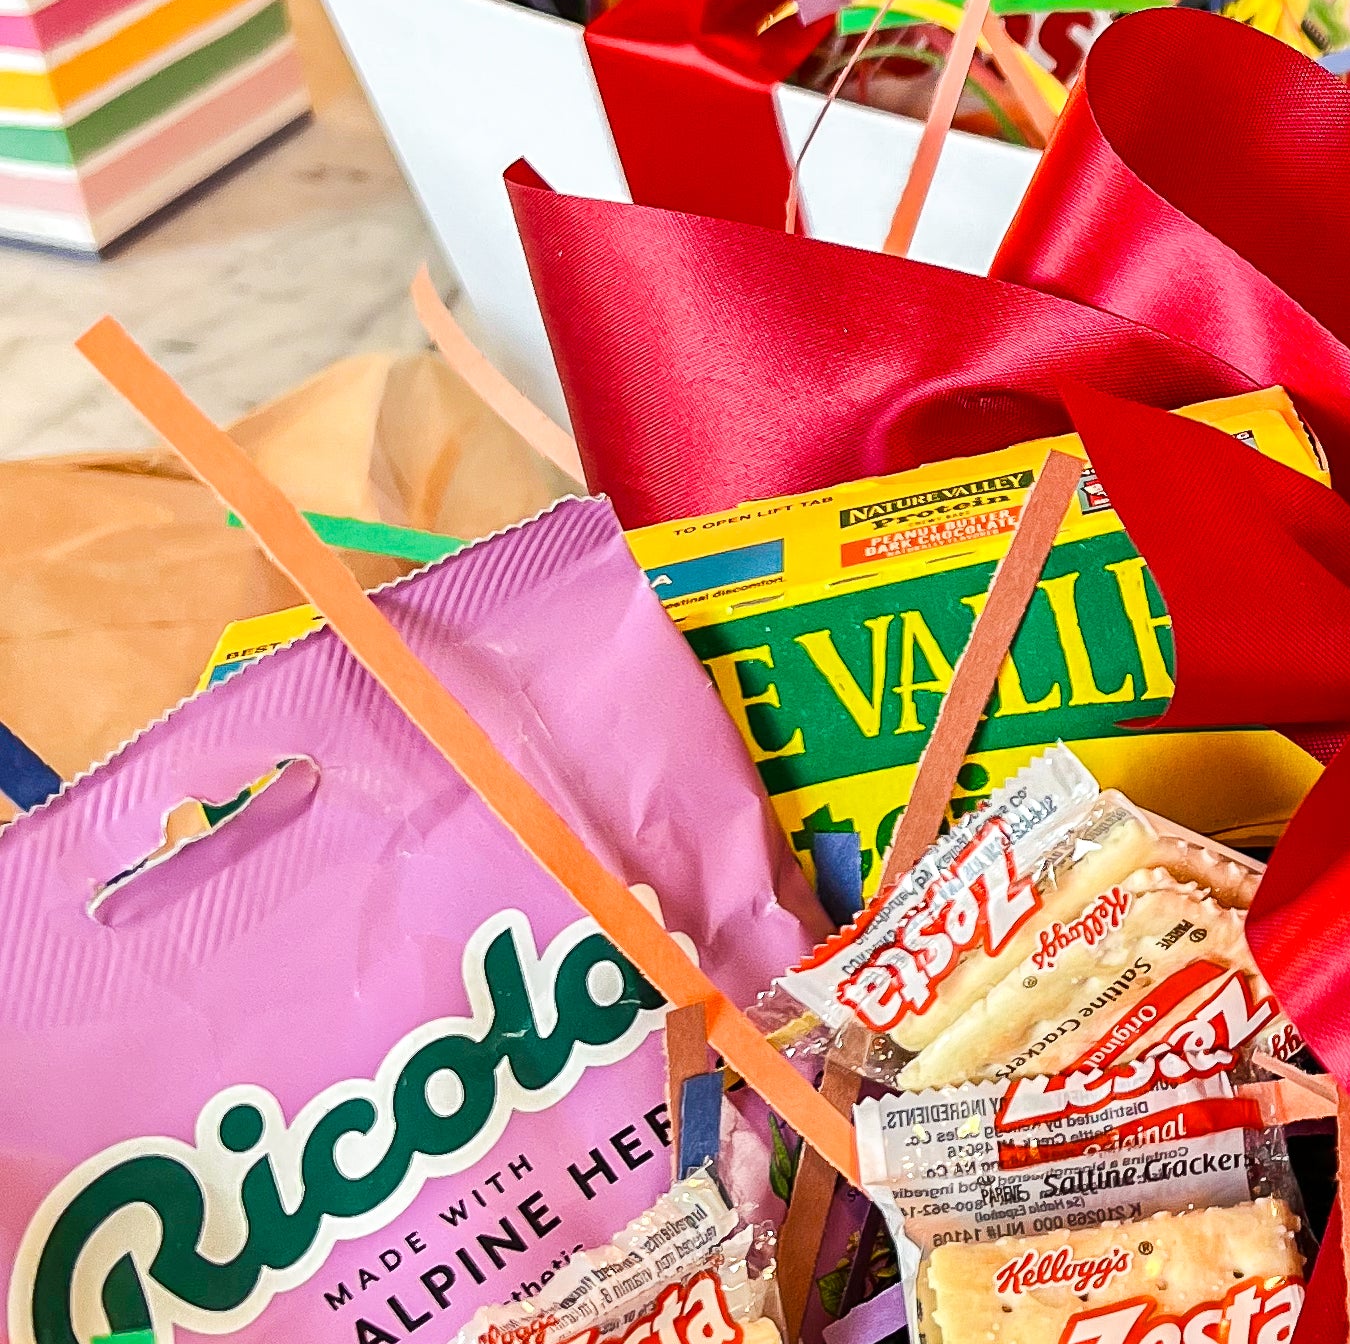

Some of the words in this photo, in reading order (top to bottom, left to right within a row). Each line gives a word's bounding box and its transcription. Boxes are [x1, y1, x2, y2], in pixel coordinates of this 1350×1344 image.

[673, 525, 697, 536] TO
[702, 514, 751, 530] OPEN
[757, 504, 794, 518] LIFT
[800, 496, 834, 508] TAB
[849, 490, 946, 524] NATURE
[944, 471, 1024, 502] VALLEY
[873, 494, 1011, 531] Protein
[864, 540, 913, 558] DARK
[914, 513, 1018, 548] CHOCOLATE
[871, 524, 943, 546] PEANUT
[945, 508, 1011, 531] BUTTER
[226, 641, 283, 660] BEST
[795, 556, 1176, 739] VALLE
[848, 821, 1038, 1030] Zesta
[1032, 886, 1131, 972] Kellogg's
[1079, 956, 1152, 1017] Saltine
[995, 1016, 1081, 1079] Crackers
[1082, 1004, 1158, 1071] Original
[1043, 1164, 1142, 1198] Saltine
[325, 1230, 428, 1312] MADE
[438, 1154, 534, 1227] WITH
[996, 1246, 1131, 1294] Kellogg's
